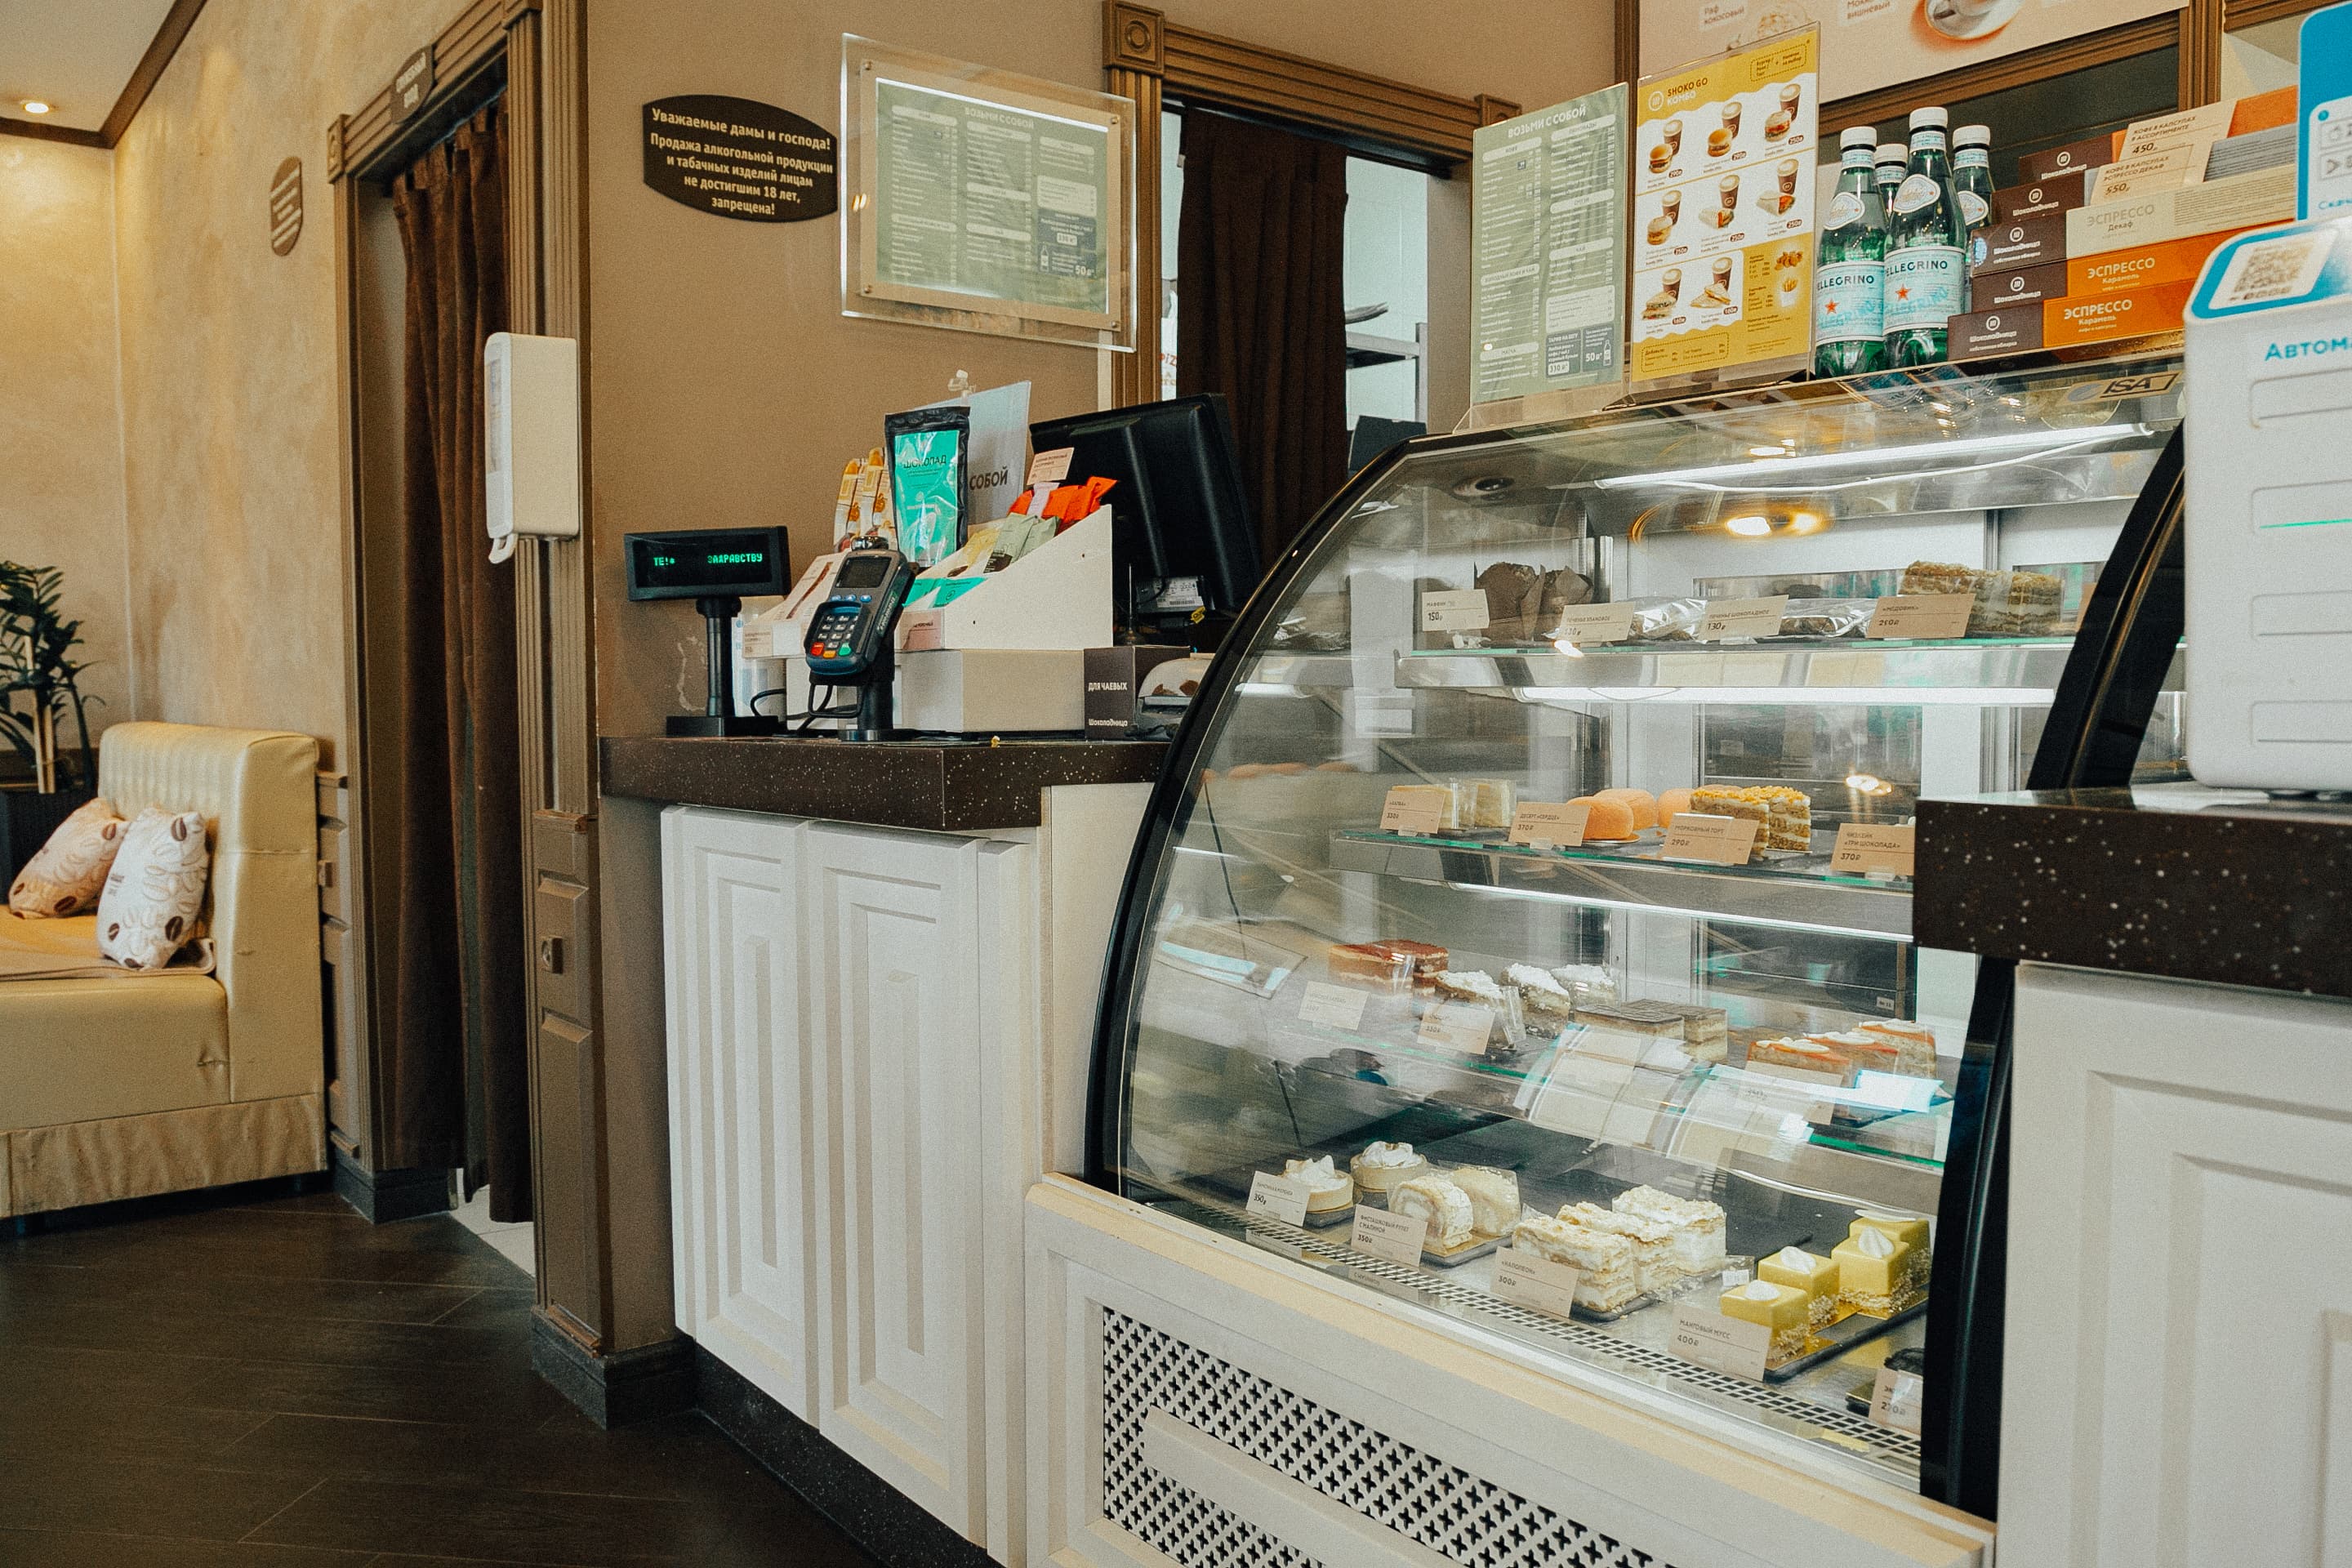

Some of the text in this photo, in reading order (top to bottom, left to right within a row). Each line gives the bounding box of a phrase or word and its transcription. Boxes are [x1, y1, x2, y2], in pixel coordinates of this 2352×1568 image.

[1667, 78, 1708, 96] SHOKO GO
[652, 108, 831, 150] Уважаемые дамы и господа!
[1508, 104, 1587, 139] ВОЗЬМИ С СОБОЙ
[2134, 127, 2153, 135] КОФЕ
[2158, 116, 2196, 130] КАПСУЛАХ
[2136, 124, 2189, 140] АССОРТИМЕНТЕ
[651, 132, 833, 174] Продажа алкогольной продукции
[666, 155, 813, 188] и табачных изделий лицам
[2041, 163, 2087, 180] Шоколадница
[2103, 163, 2165, 181] ЭСПРЕССО ДЕКАФ
[2105, 166, 2124, 175] КОФЕ
[2130, 156, 2170, 169] КАПСУЛАХ
[684, 176, 801, 203] не достигшим 18 лет,
[711, 197, 775, 215] запрещена!
[2012, 201, 2059, 216] Шоколадница
[2087, 203, 2155, 227] ЭСПРЕССО
[2108, 220, 2134, 232] Декаф
[1993, 240, 2041, 255] Шоколадница
[2087, 257, 2156, 279] ЭСПРЕССО
[2102, 274, 2140, 285] Карамель
[1993, 290, 2042, 304] Шоколадница
[2064, 299, 2132, 320] ЭСПРЕССО
[2078, 314, 2117, 326] Карамель
[1969, 330, 2017, 343] Шоколадница
[2265, 336, 2352, 362] Автом
[969, 466, 1009, 490] СОБОЙ
[1088, 682, 1128, 692] ДЛЯ ЧАЕВЫХ
[1089, 718, 1128, 727] Шоколадница
[1713, 1330, 1731, 1339] МУСС
